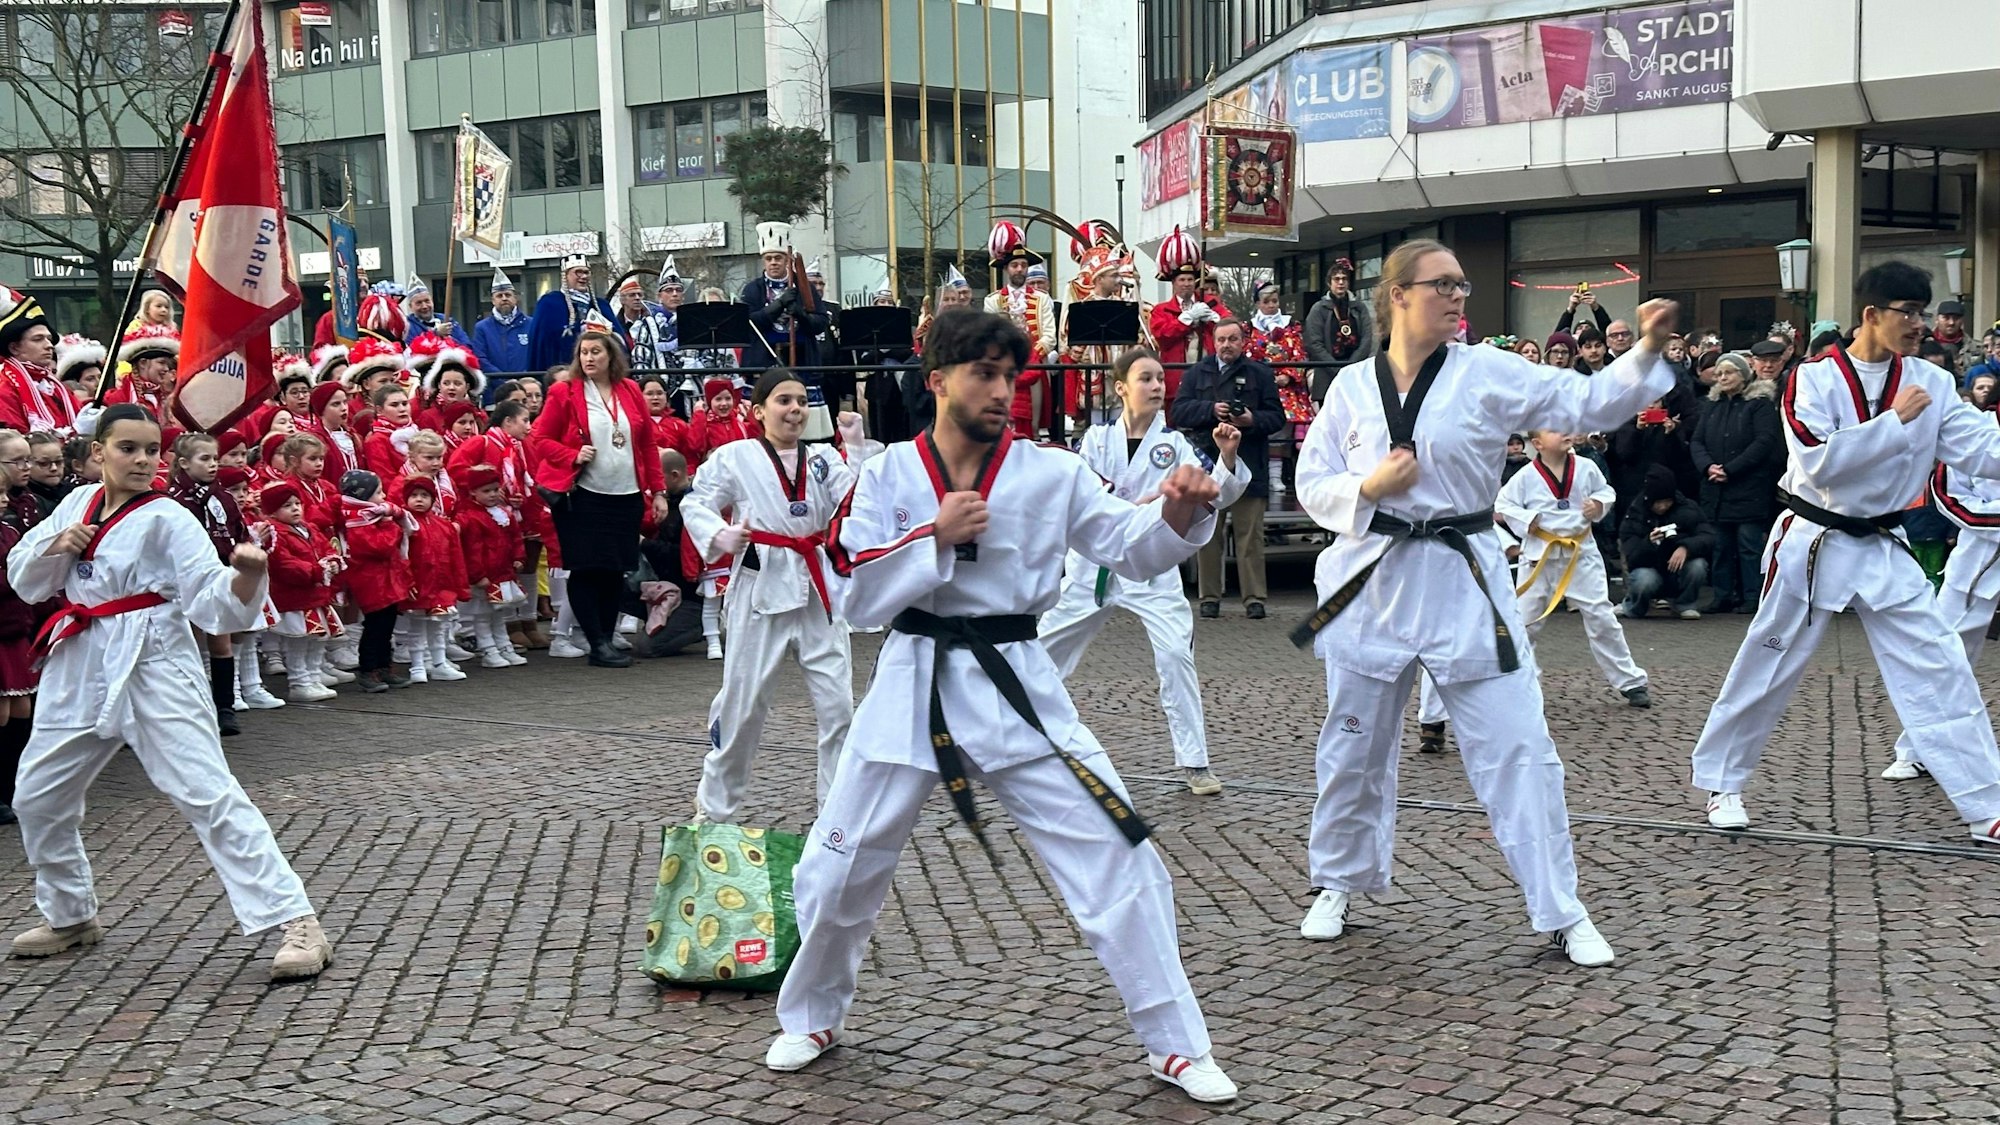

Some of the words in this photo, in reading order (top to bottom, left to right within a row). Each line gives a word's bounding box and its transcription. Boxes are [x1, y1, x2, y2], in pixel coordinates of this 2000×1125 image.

[1630, 40, 1733, 81] ARCHI
[1294, 66, 1385, 107] CLUB
[1499, 71, 1534, 89] Acta
[1636, 87, 1679, 101] SANKT
[242, 218, 276, 290] GARDE
[740, 943, 762, 951] REWE
